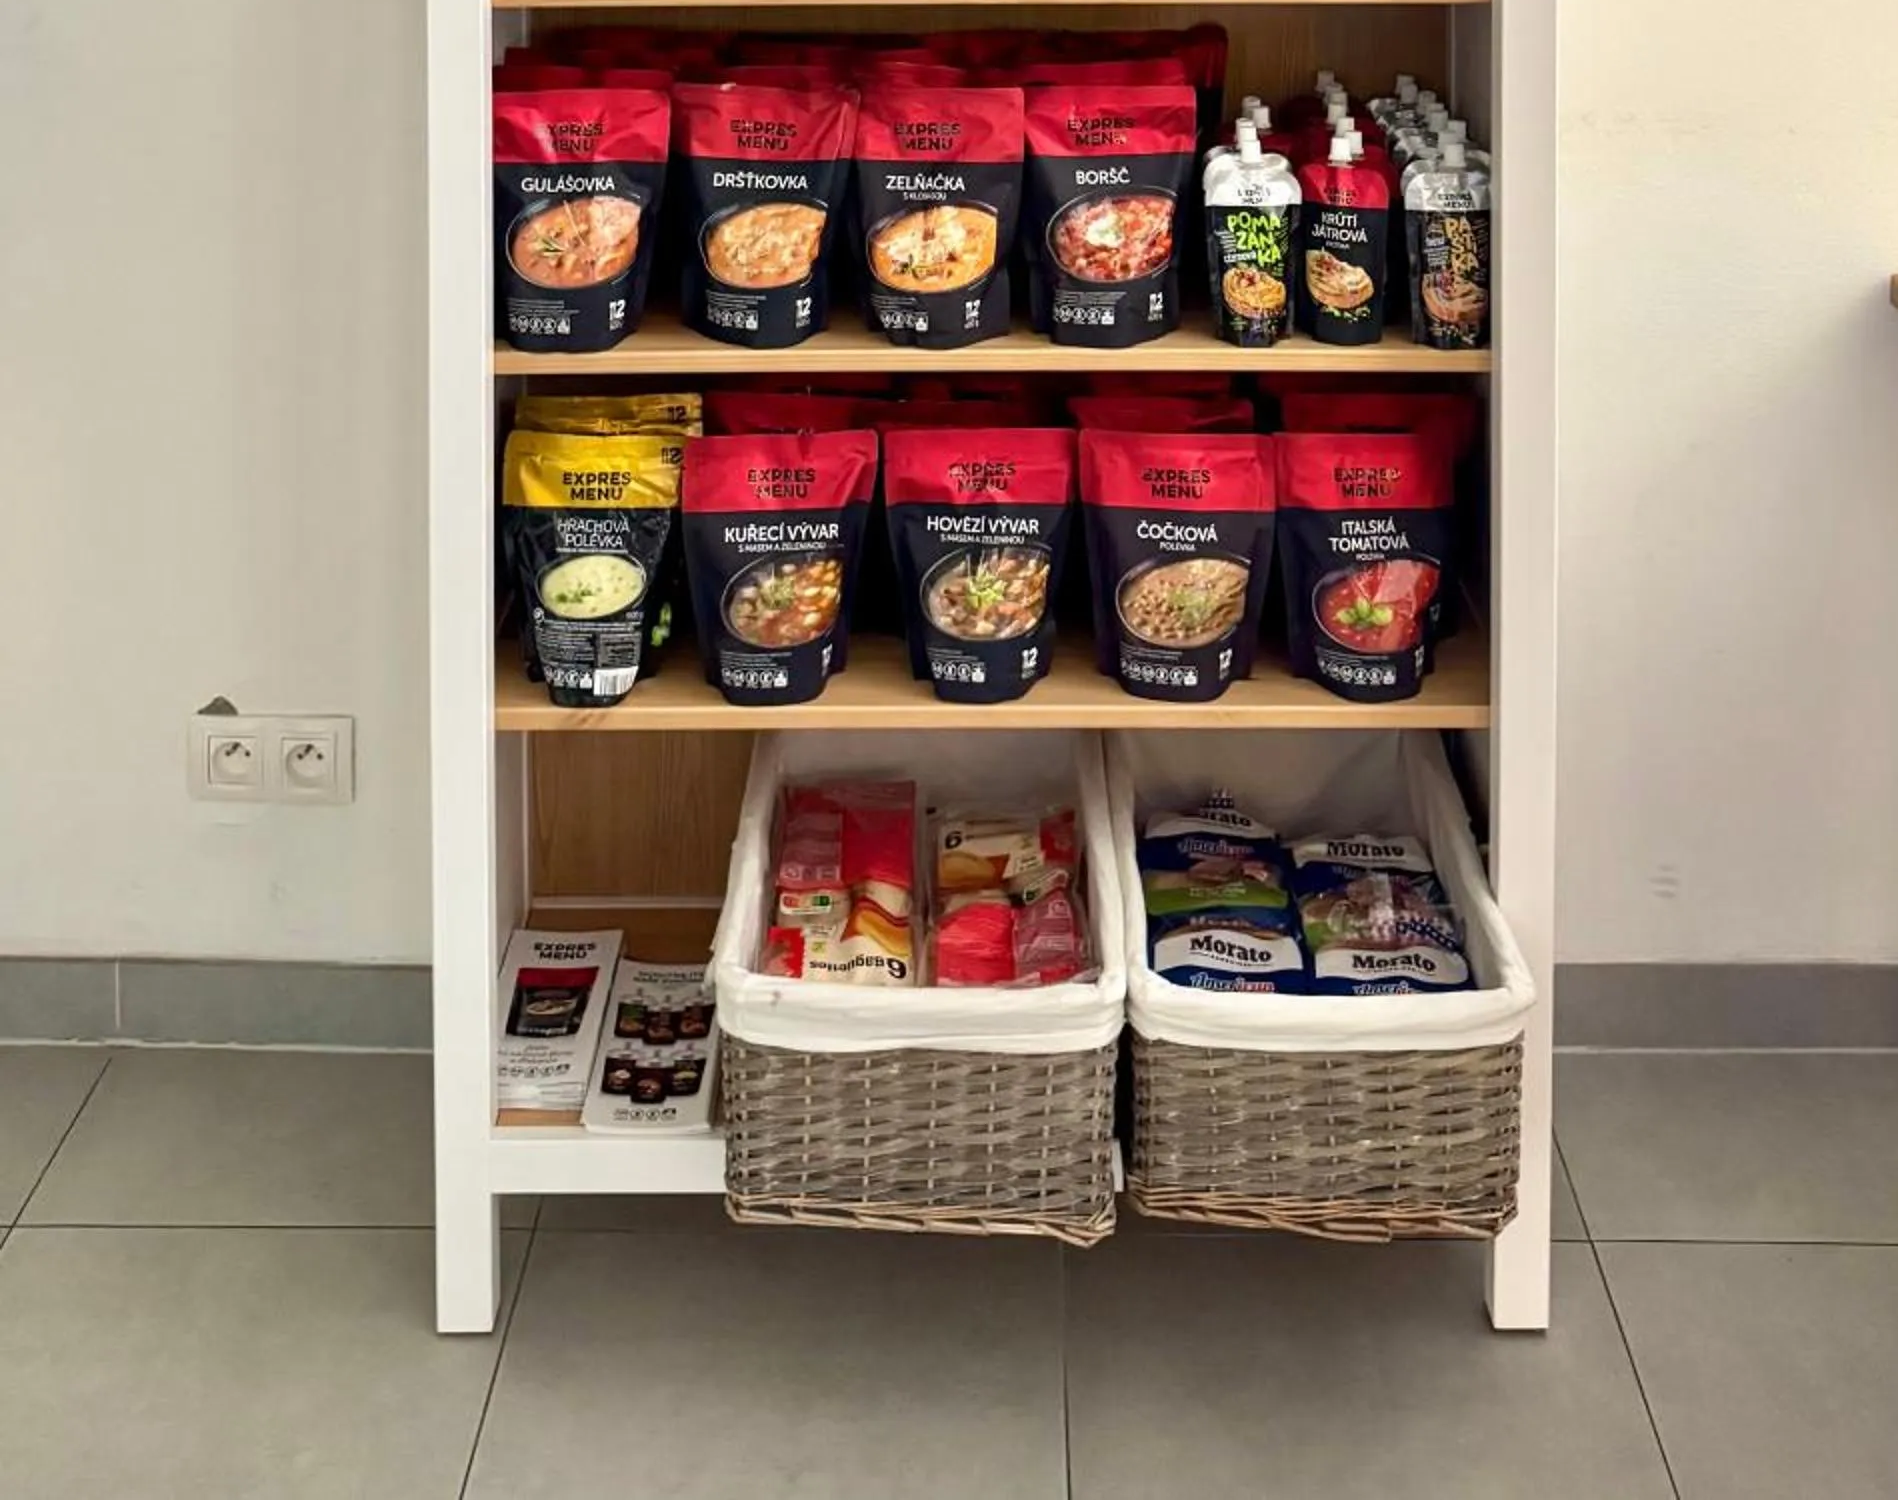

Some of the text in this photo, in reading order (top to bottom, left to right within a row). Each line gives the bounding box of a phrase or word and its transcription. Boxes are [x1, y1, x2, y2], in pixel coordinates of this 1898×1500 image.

[731, 120, 798, 138] EXPRES
[894, 122, 961, 136] EXPRES
[1067, 117, 1136, 132] EXPRES
[738, 136, 788, 150] MENU
[904, 138, 953, 150] MENU
[521, 174, 616, 193] GULÁŠOVKA
[713, 172, 808, 189] DRŠŤKOVKA
[886, 173, 966, 191] ZELŇAČKA
[1076, 166, 1130, 184] BORŠČ
[1227, 211, 1281, 232] POMA
[1312, 224, 1369, 243] JÁTROVÁ
[1258, 244, 1281, 268] KA
[562, 471, 631, 486] EXPRES
[748, 468, 816, 483] EXPRES
[1142, 468, 1211, 484] EXPRES
[570, 486, 624, 501] MENU
[756, 484, 808, 498] MENU
[1151, 484, 1203, 499] MENU
[1342, 483, 1391, 498] MENU
[558, 517, 630, 534] HRACHOVÁ
[725, 520, 840, 543] KUŘECÍ VÝVAR
[927, 515, 1040, 535] HOVĚZÍ VÝVAR
[1136, 520, 1218, 542] ČOČKOVÁ
[1342, 516, 1396, 535] ITALSKÁ
[565, 533, 624, 548] POLÉVKA
[1328, 532, 1410, 552] TOMATOVÁ
[1022, 647, 1038, 669] 12
[1327, 841, 1406, 858] Morato
[533, 942, 597, 952] EXPRES
[539, 951, 588, 960] MENU
[1189, 935, 1273, 964] Morato
[1352, 954, 1437, 973] Morato
